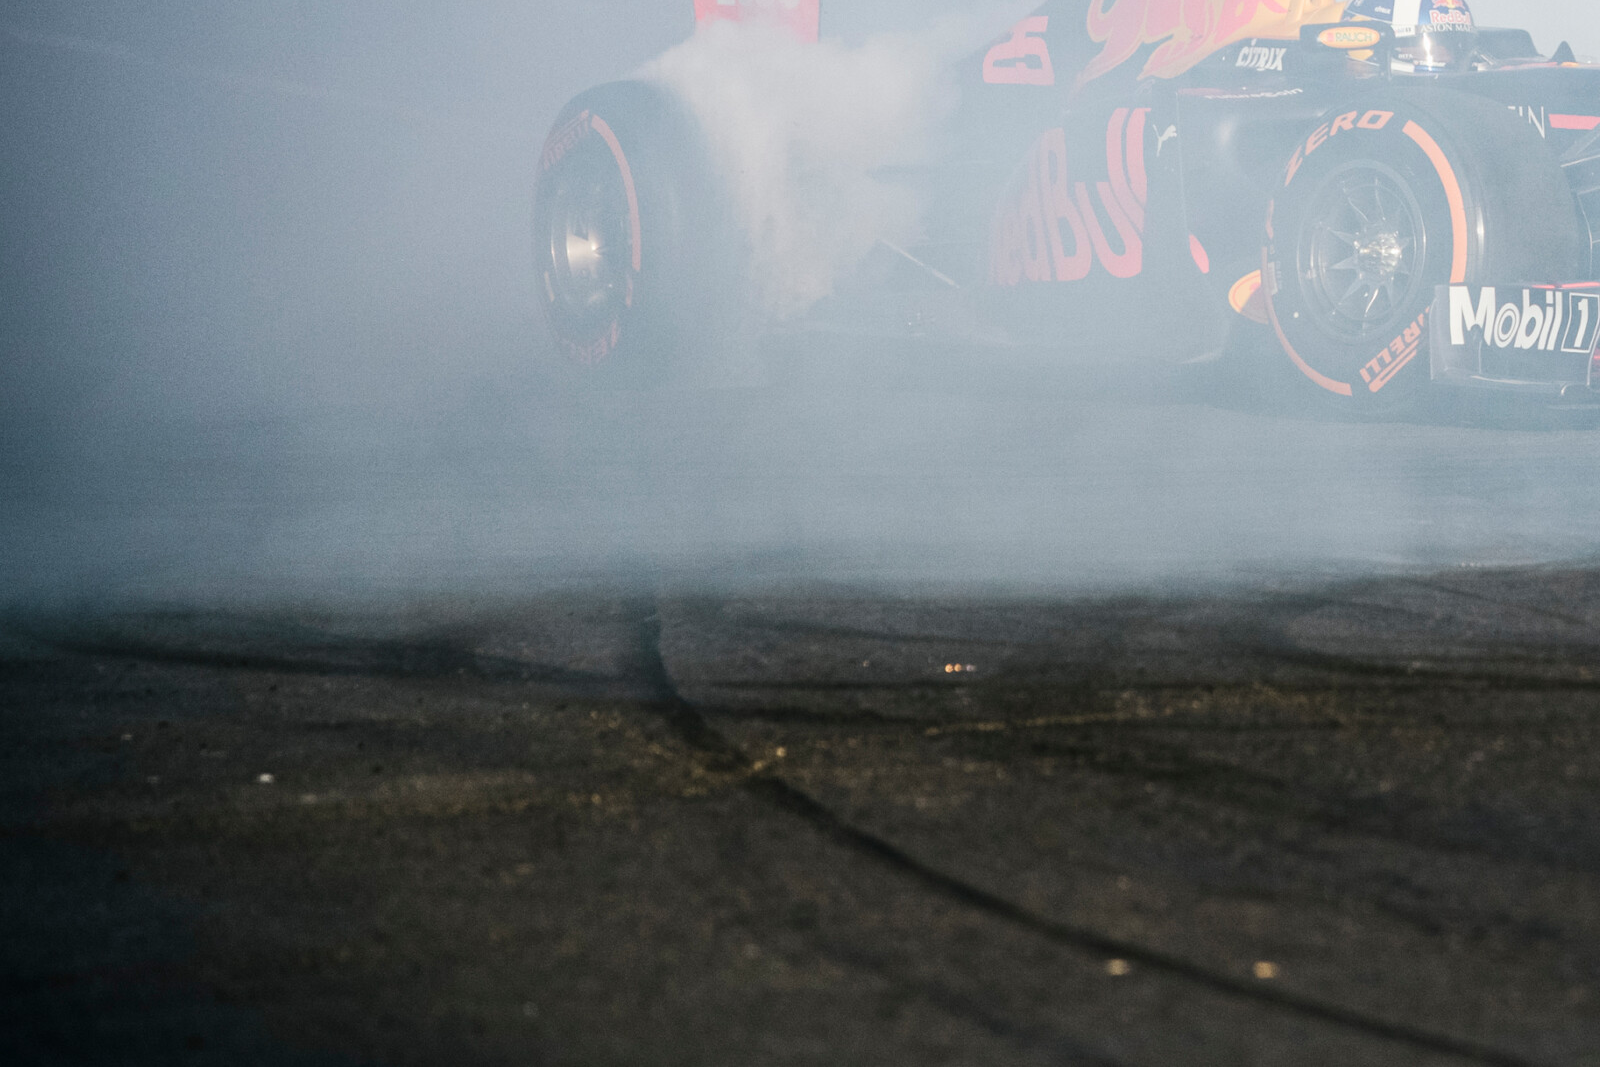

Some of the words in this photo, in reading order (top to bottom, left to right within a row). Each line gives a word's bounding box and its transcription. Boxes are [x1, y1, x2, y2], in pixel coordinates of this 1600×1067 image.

[1335, 32, 1373, 43] RAUCH
[1284, 109, 1395, 187] ZERO
[1449, 285, 1563, 350] Mobil
